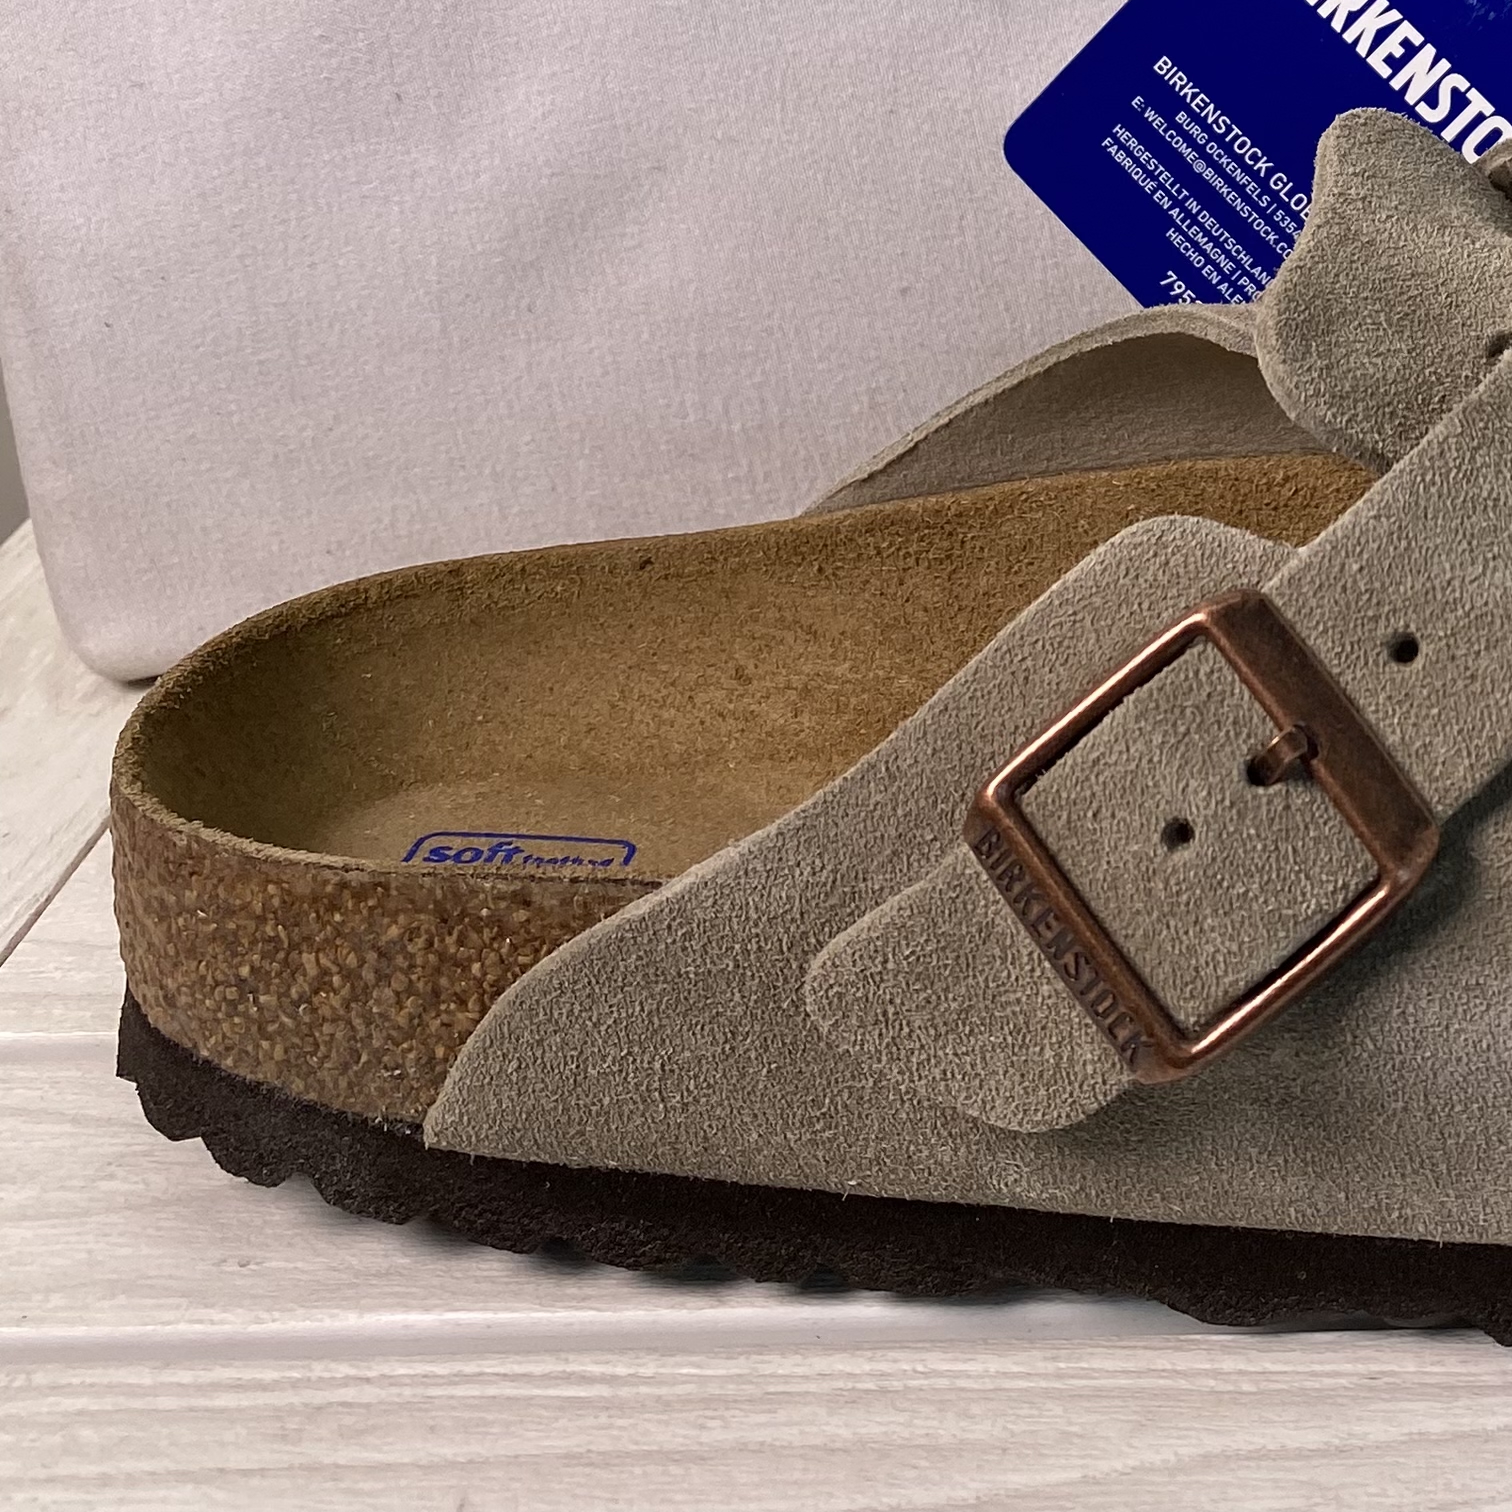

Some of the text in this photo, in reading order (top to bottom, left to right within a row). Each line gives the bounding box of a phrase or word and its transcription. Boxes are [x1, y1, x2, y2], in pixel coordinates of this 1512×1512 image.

[1131, 95, 1146, 112] E:
[1153, 55, 1275, 178] BIRKENSTOCK
[1101, 136, 1159, 195] FABRIQUÉ
[1152, 189, 1173, 210] EN
[1168, 207, 1237, 275] ALLEMAGNE
[1112, 123, 1274, 288] HERGESTELLT IN DEUTSCHLAN
[1175, 111, 1209, 145] BURG
[1205, 141, 1271, 208] OCKENFELS
[1160, 270, 1203, 305] 795
[1165, 227, 1246, 305] HECHO EN ALE
[423, 841, 525, 865] soft
[974, 826, 1154, 1067] BIRKENSTOCK
